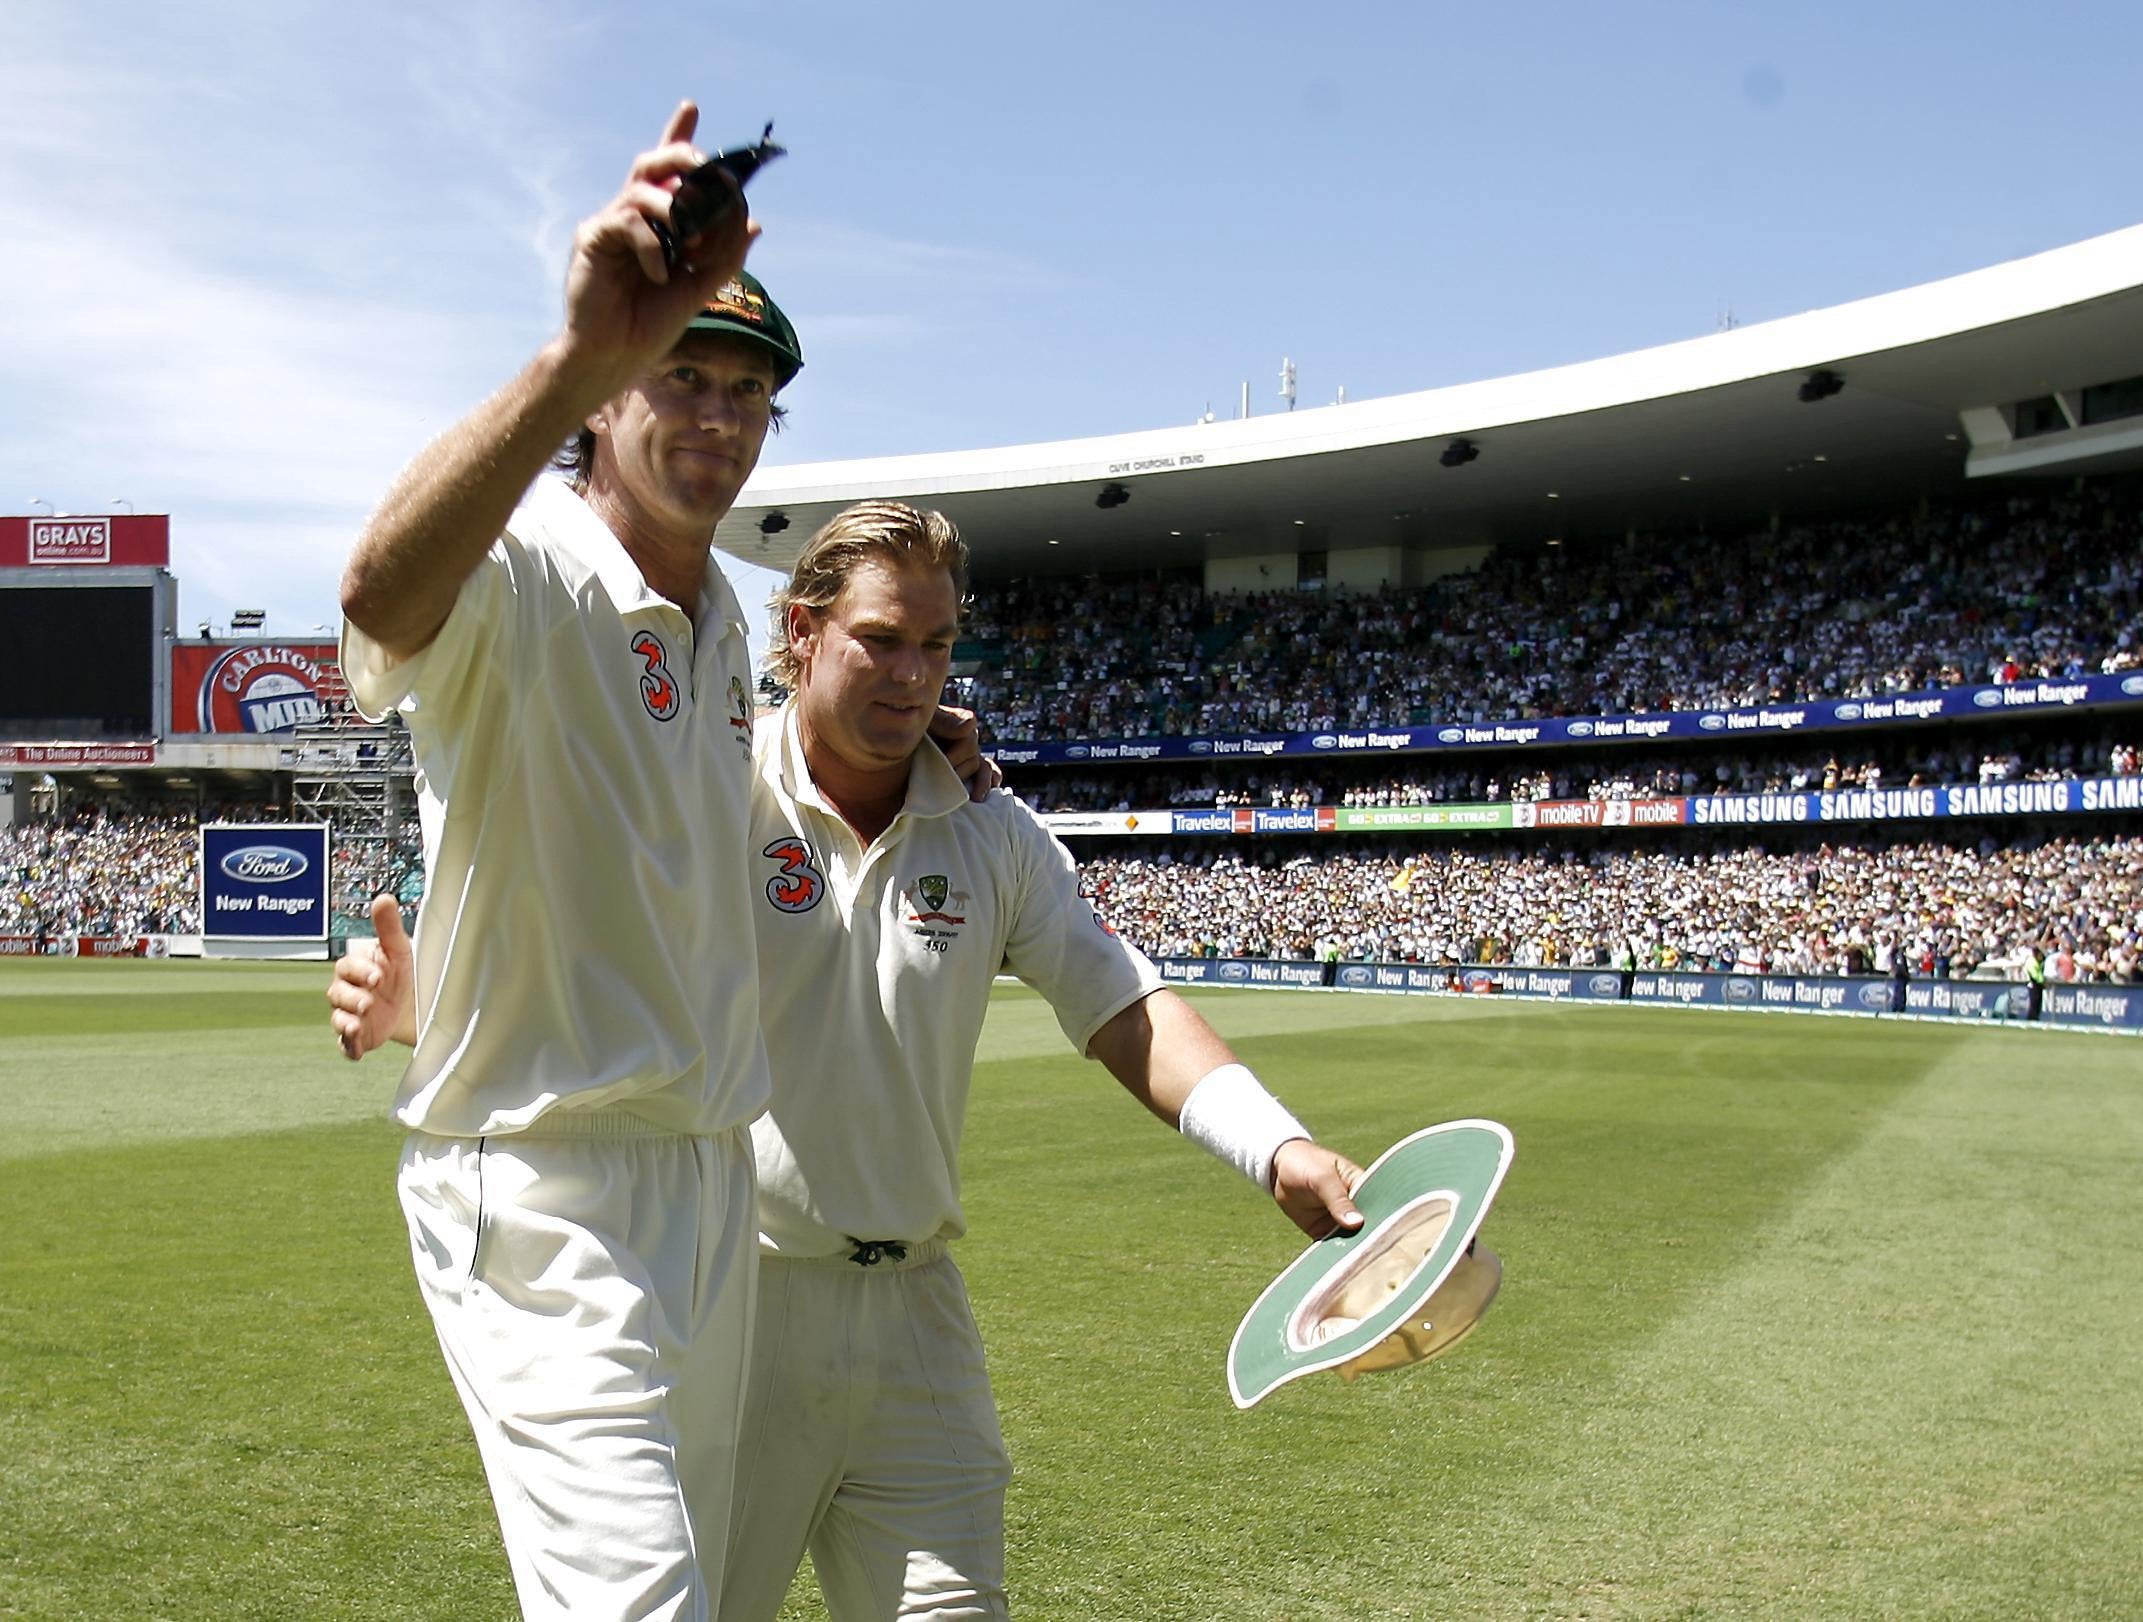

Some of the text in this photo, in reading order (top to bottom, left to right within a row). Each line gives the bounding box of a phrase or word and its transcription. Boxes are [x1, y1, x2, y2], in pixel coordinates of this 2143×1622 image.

[36, 526, 104, 545] GRAYS
[222, 646, 322, 693] CARLTON
[2004, 688, 2034, 705] New
[2037, 684, 2088, 705] Ranger
[248, 697, 321, 734] MID
[1863, 703, 1893, 719] New
[1895, 699, 1942, 718] Ranger
[1595, 721, 1623, 735] New
[1626, 720, 1670, 737] Ranger
[1728, 713, 1757, 729] New
[1759, 711, 1804, 729] Ranger
[1338, 734, 1366, 748] New
[1368, 733, 1410, 750] Ranger
[1465, 728, 1493, 742] New
[1496, 727, 1539, 744] Ranger
[25, 748, 44, 760] The
[47, 748, 81, 760] Online
[84, 748, 149, 760] Auctioneers
[997, 749, 1038, 763] Ranger
[1091, 745, 1118, 757] New
[1120, 743, 1161, 757] Ranger
[1214, 740, 1241, 753] New
[1243, 739, 1285, 754] Ranger
[1948, 783, 2068, 815] SAMSUNG
[2082, 778, 2143, 810] SAM
[1635, 802, 1677, 822] mobile
[1694, 795, 1807, 823] SAMSUNG
[1819, 790, 1935, 820] SAMSUNG
[1174, 814, 1231, 831] Travelex
[1257, 812, 1314, 830] Travelex
[238, 851, 291, 876] Ford
[763, 837, 825, 913] 3
[216, 894, 315, 915] New Ranger
[1164, 961, 1206, 981] Ranger
[1251, 963, 1279, 980] New
[1377, 968, 1403, 985] New
[1528, 974, 1571, 995] Ranger
[1658, 978, 1704, 1001] Ranger
[1762, 981, 1792, 1000] New
[1795, 982, 1845, 1007] Ranger
[1933, 986, 1983, 1015] Ranger
[2077, 988, 2128, 1022] Ranger
